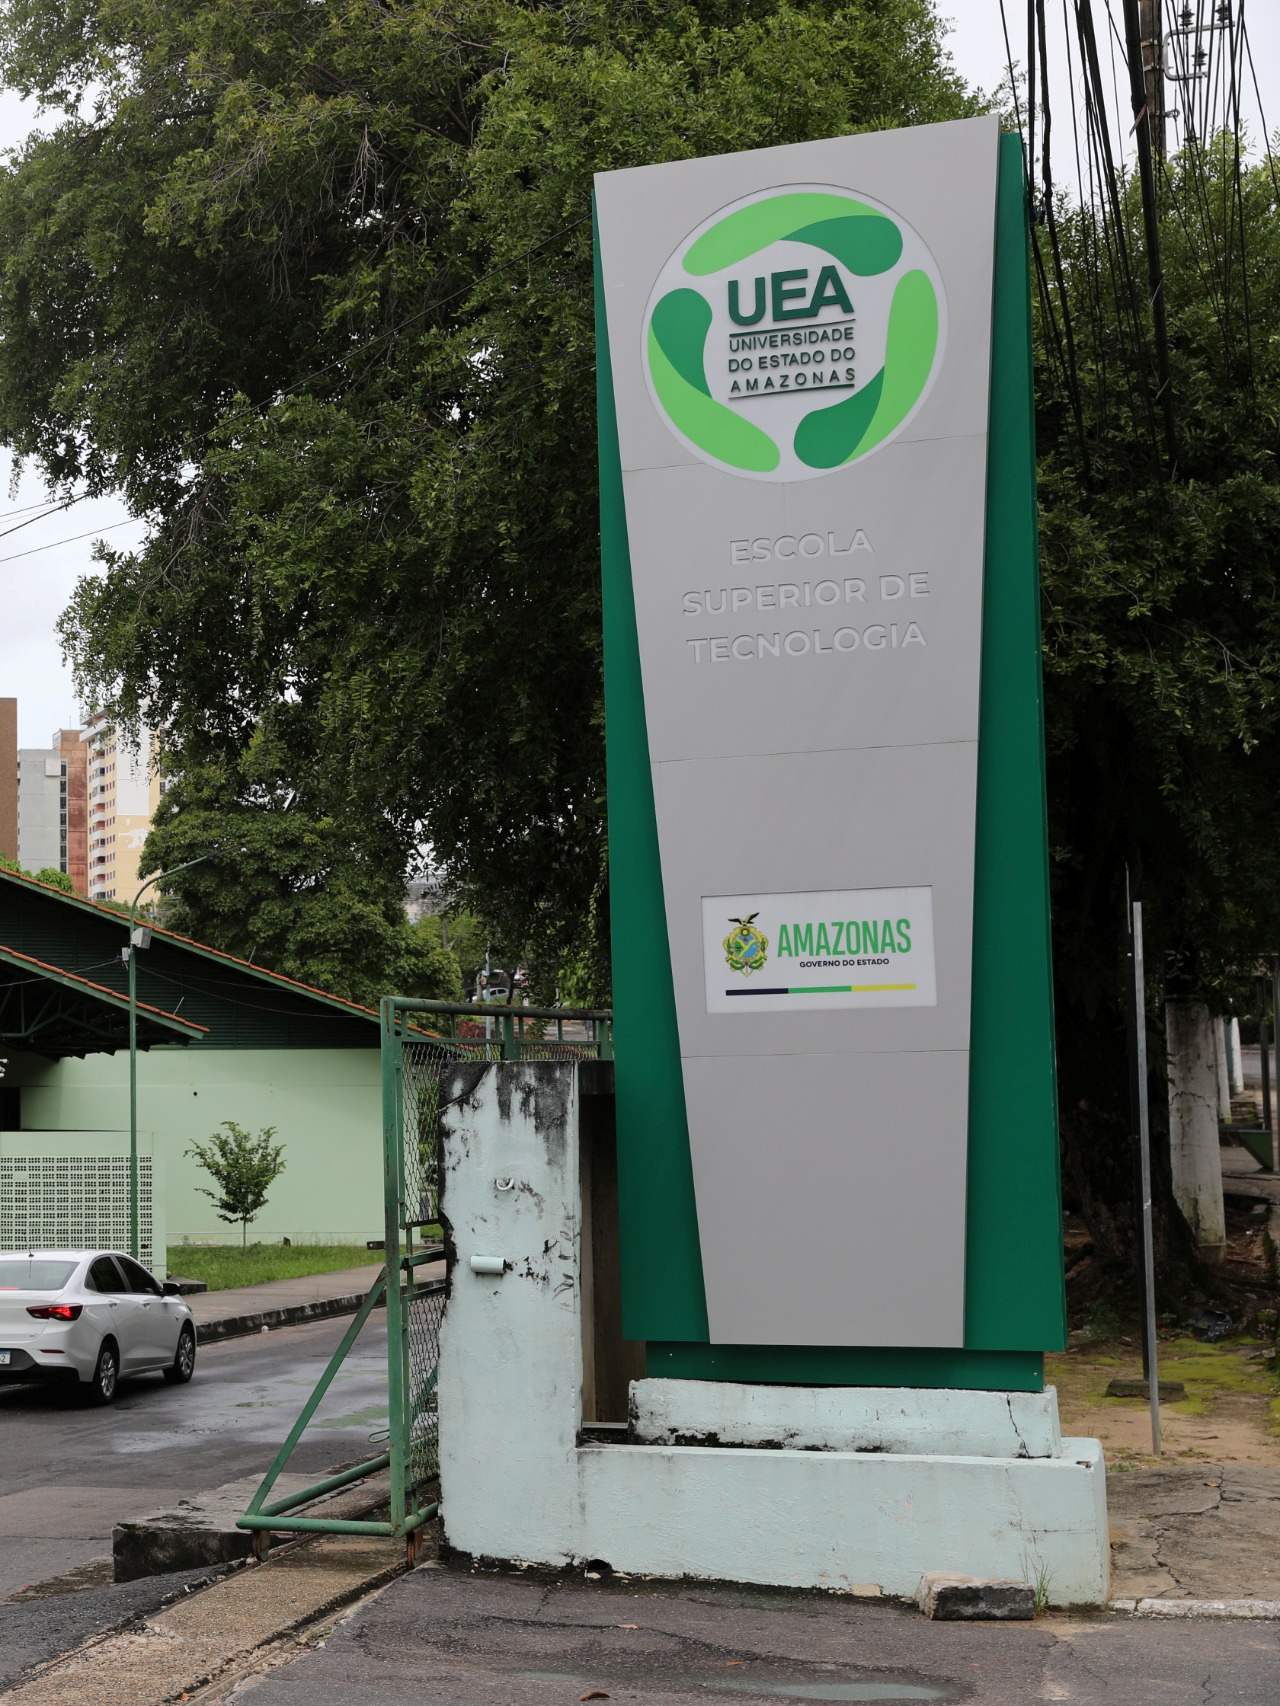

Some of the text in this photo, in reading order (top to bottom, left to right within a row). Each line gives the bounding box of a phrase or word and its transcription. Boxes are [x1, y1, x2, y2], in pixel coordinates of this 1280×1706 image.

[727, 264, 855, 326] UEA
[729, 326, 855, 353] UNIVERSIDADE
[728, 346, 856, 373] DO ESTADO DO
[730, 367, 856, 393] AMAZONAS
[729, 528, 875, 566] ESCOLA
[682, 571, 930, 617] SUPERIOR DE
[686, 621, 927, 664] TECNOLOGIA
[777, 918, 912, 958] AMAZONAS
[799, 958, 890, 968] GOVERNO DO ESTADO
